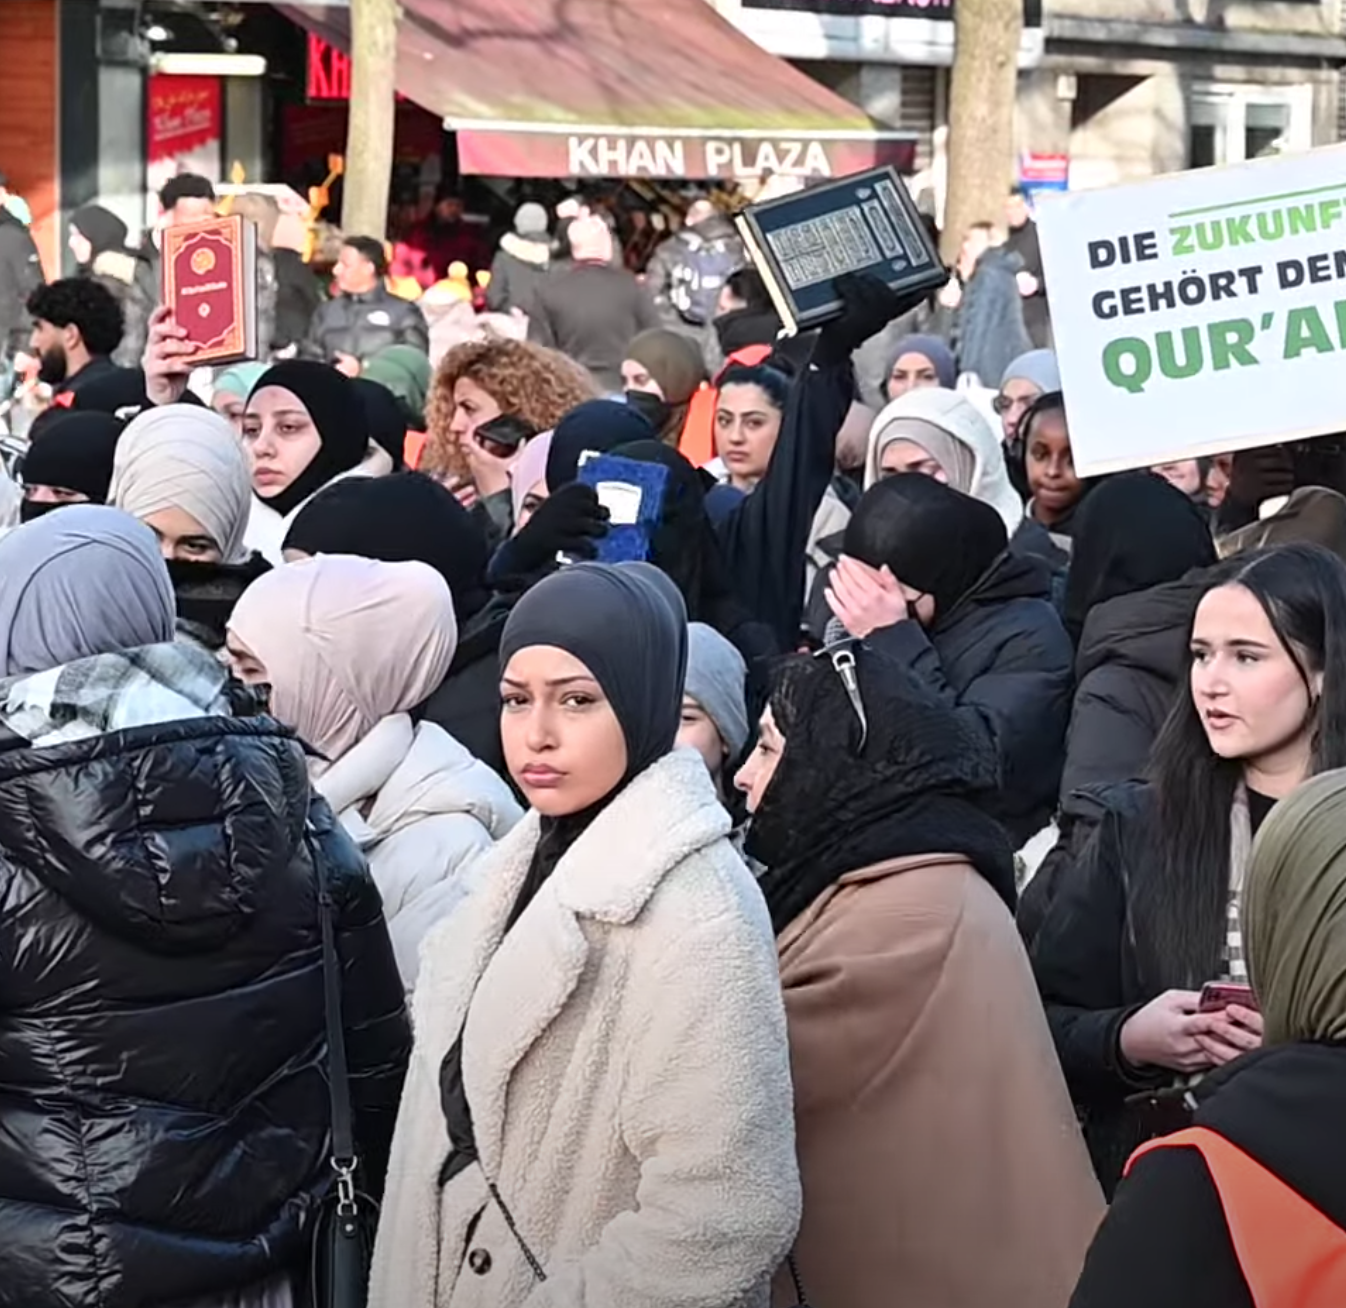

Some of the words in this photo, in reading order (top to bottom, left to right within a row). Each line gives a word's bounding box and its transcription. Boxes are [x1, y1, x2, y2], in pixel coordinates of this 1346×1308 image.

[308, 30, 352, 99] KH
[567, 136, 685, 176] KHAN
[705, 140, 831, 176] PLAZA
[1087, 231, 1160, 270] DIE
[1091, 264, 1264, 321] GEHÖRT
